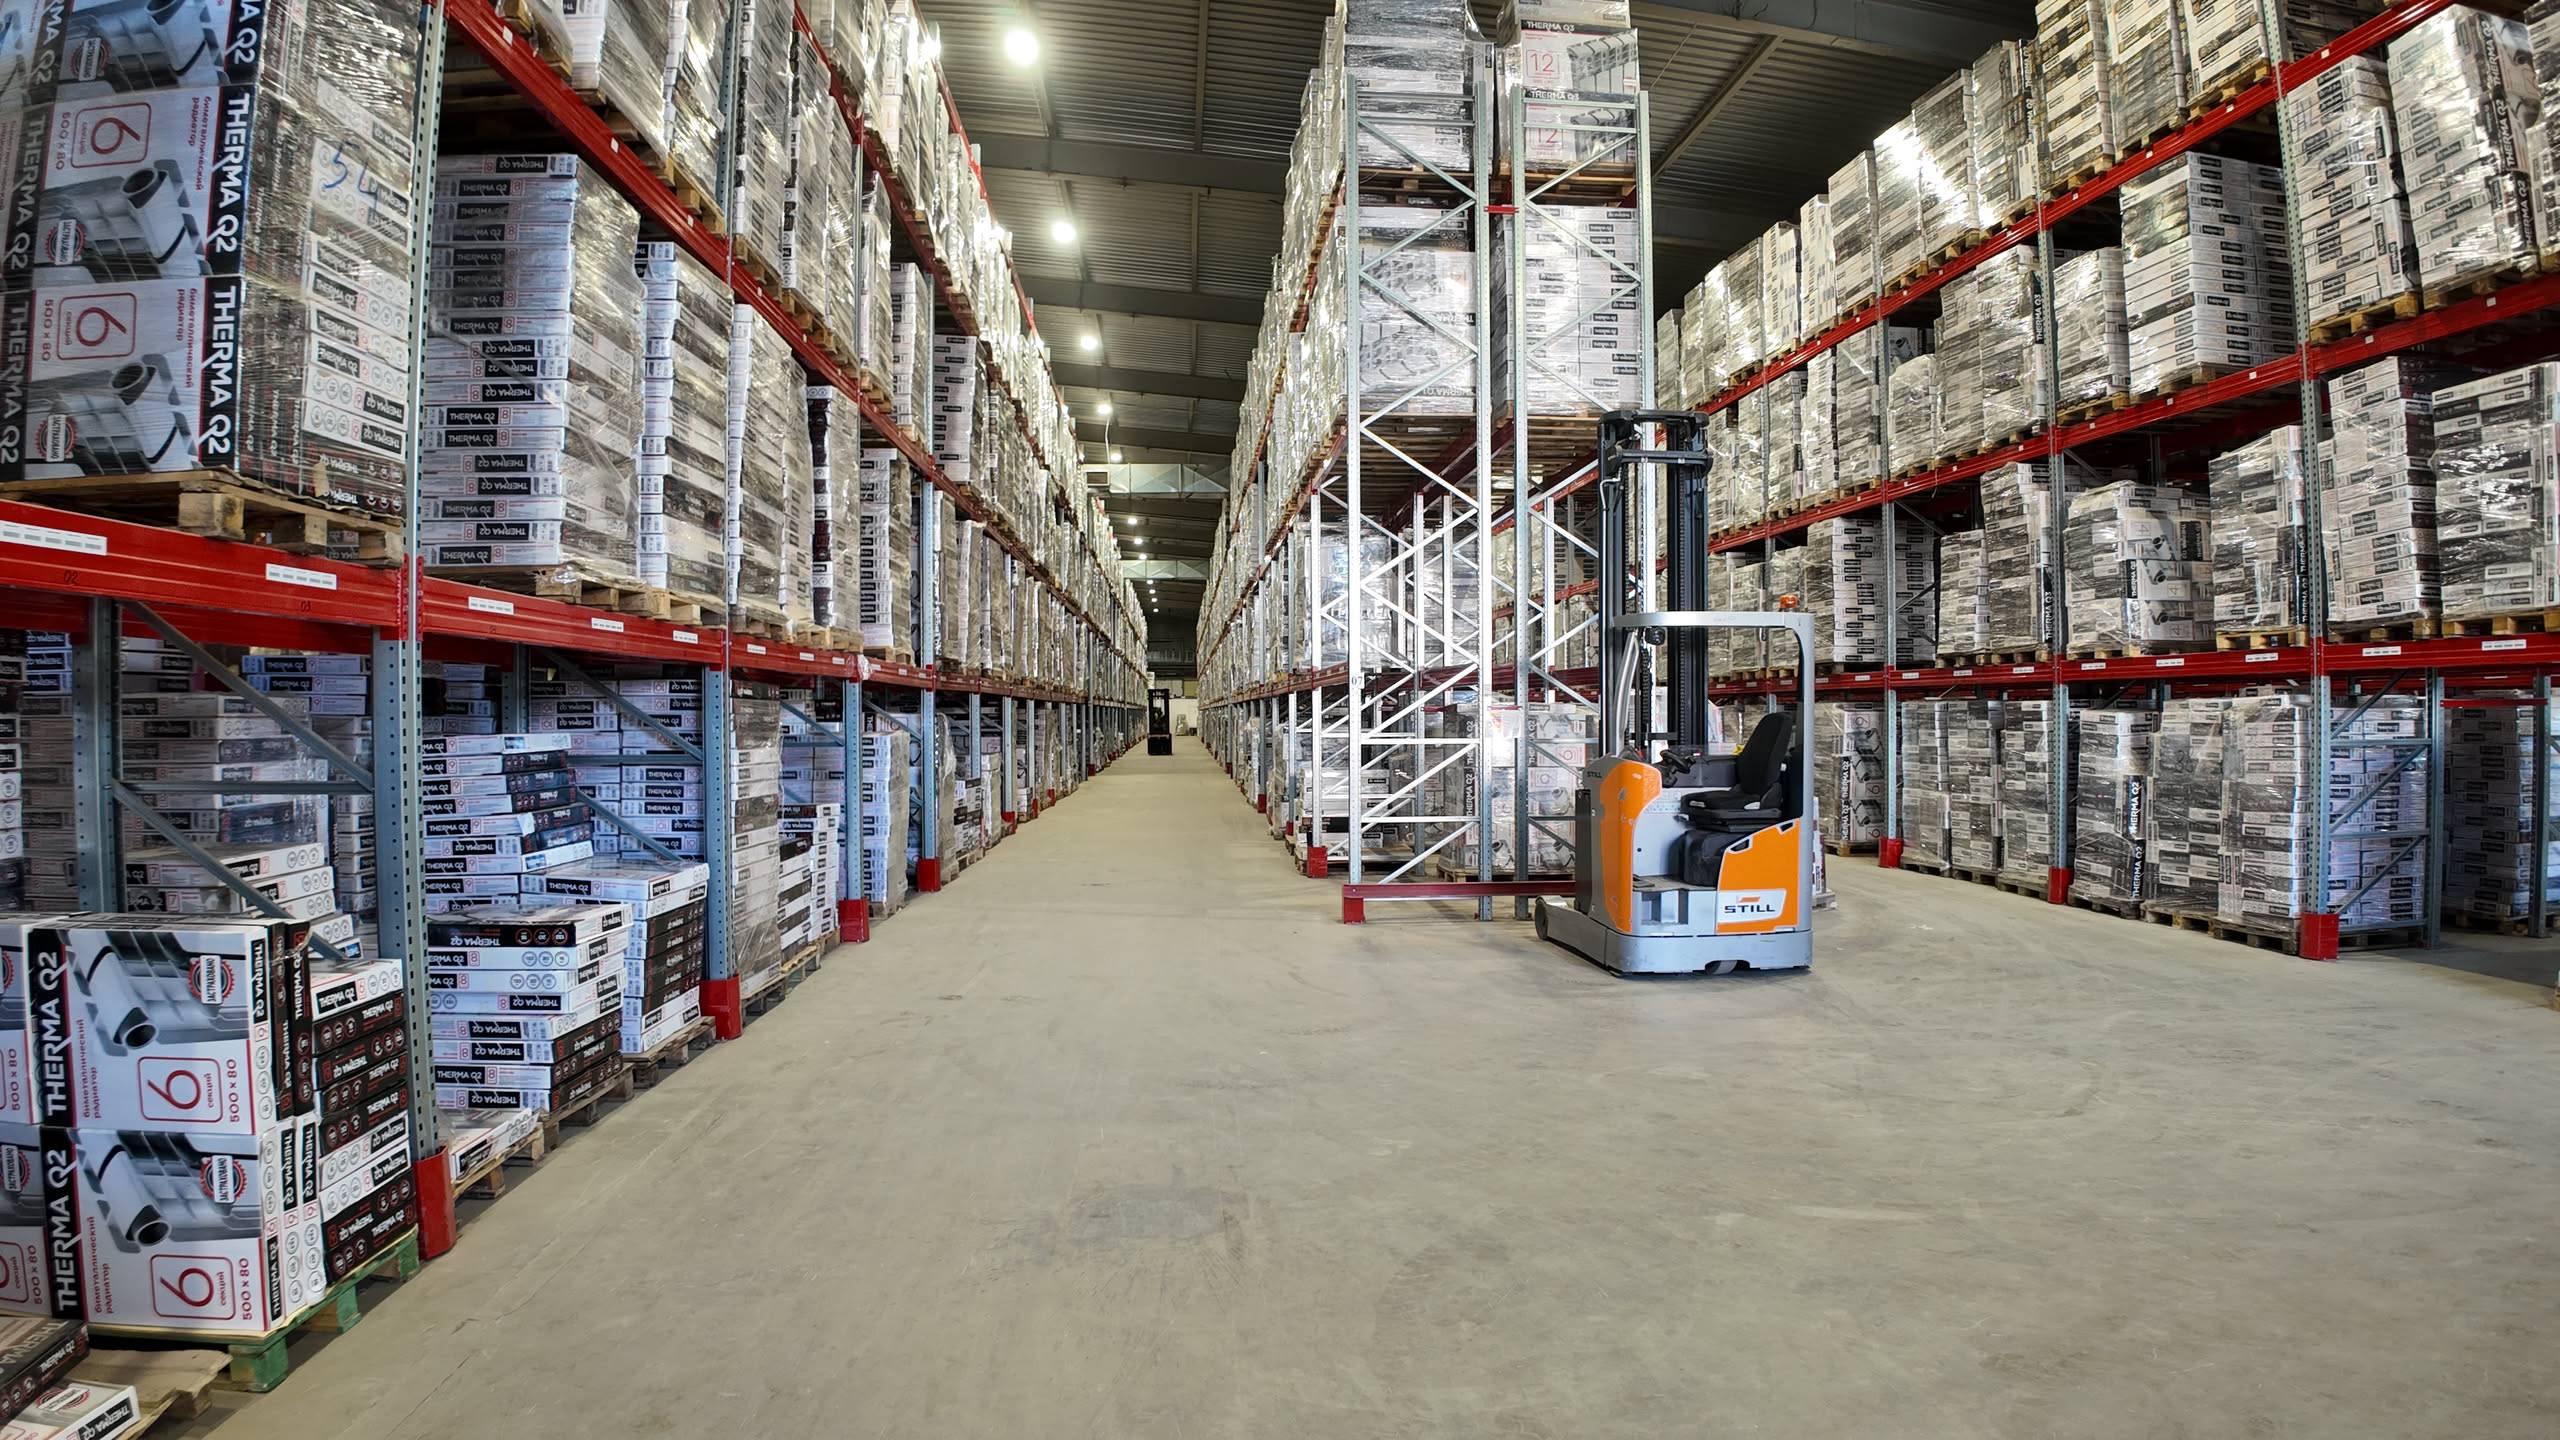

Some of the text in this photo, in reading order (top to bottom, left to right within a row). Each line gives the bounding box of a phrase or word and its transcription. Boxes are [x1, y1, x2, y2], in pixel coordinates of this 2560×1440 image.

[1527, 21, 1575, 32] THERMA Q3
[224, 28, 256, 65] Q2
[1530, 53, 1554, 72] 12
[2481, 21, 2501, 85] THERMA Q2
[91, 117, 140, 155] 6
[188, 97, 200, 147] радиатор
[2497, 99, 2516, 167] THERMA Q2
[196, 97, 212, 190] биметаллический
[206, 93, 249, 253] THERMA Q2
[501, 157, 545, 169] THERMA Q2
[2, 115, 46, 271] THERMA Q2
[462, 184, 508, 196] THERMA Q2
[58, 221, 73, 263] ЗАСТРАХОВАНО
[76, 307, 127, 346] 6
[176, 289, 186, 341] радиатор
[454, 322, 500, 334] THERMA Q2
[185, 288, 197, 388] биметаллический
[198, 285, 236, 454] THERMA Q2
[485, 384, 531, 397] THERMA Q2
[450, 412, 495, 425] THERMA Q2
[48, 416, 62, 459] ЗАСТРАХОВАНО
[448, 434, 494, 446] THERMA Q2
[478, 455, 524, 468] THERMA Q2
[481, 478, 527, 490] THERMA Q2
[446, 504, 491, 516] THERMA Q2
[479, 524, 525, 536] THERMA Q2
[443, 550, 489, 563] THERMA Q2
[1351, 676, 1363, 686] 07
[1724, 904, 1775, 914] STILL
[205, 958, 217, 1003] ЗАСТРАХОВАНО
[251, 944, 264, 1017] THERMA Q2
[319, 988, 344, 1007] THERMA
[512, 994, 524, 1006] Q2
[526, 995, 558, 1006] THERMA
[38, 952, 72, 1115] THERMA Q2
[469, 1021, 483, 1033] Q2
[484, 1021, 518, 1033] THERMA
[475, 1043, 486, 1055] Q2
[488, 1043, 521, 1055] THERMA
[76, 1019, 90, 1119] биметаллический
[227, 1059, 236, 1079] 80
[437, 1071, 469, 1083] THERMA
[471, 1072, 482, 1084] Q2
[92, 1067, 102, 1119] радиатор
[148, 1070, 201, 1109] 6
[204, 1073, 214, 1108] секций
[472, 1091, 483, 1102] Q2
[484, 1091, 516, 1103] THERMA
[230, 1093, 239, 1123] 500
[283, 1133, 294, 1204] THERMA Q2
[303, 1126, 314, 1197] THERMA Q2
[218, 1157, 229, 1201] ЗАСТРАХОВАНО
[47, 1150, 82, 1311] THERMA Q2
[87, 1216, 103, 1314] биметаллический
[239, 1257, 249, 1278] 80
[269, 1241, 281, 1314] THERMA Q2
[103, 1263, 114, 1314] радиатор
[160, 1267, 214, 1307] 6
[215, 1271, 227, 1306] секций
[242, 1291, 252, 1320] 500
[82, 1404, 130, 1438] THERMA Q2
